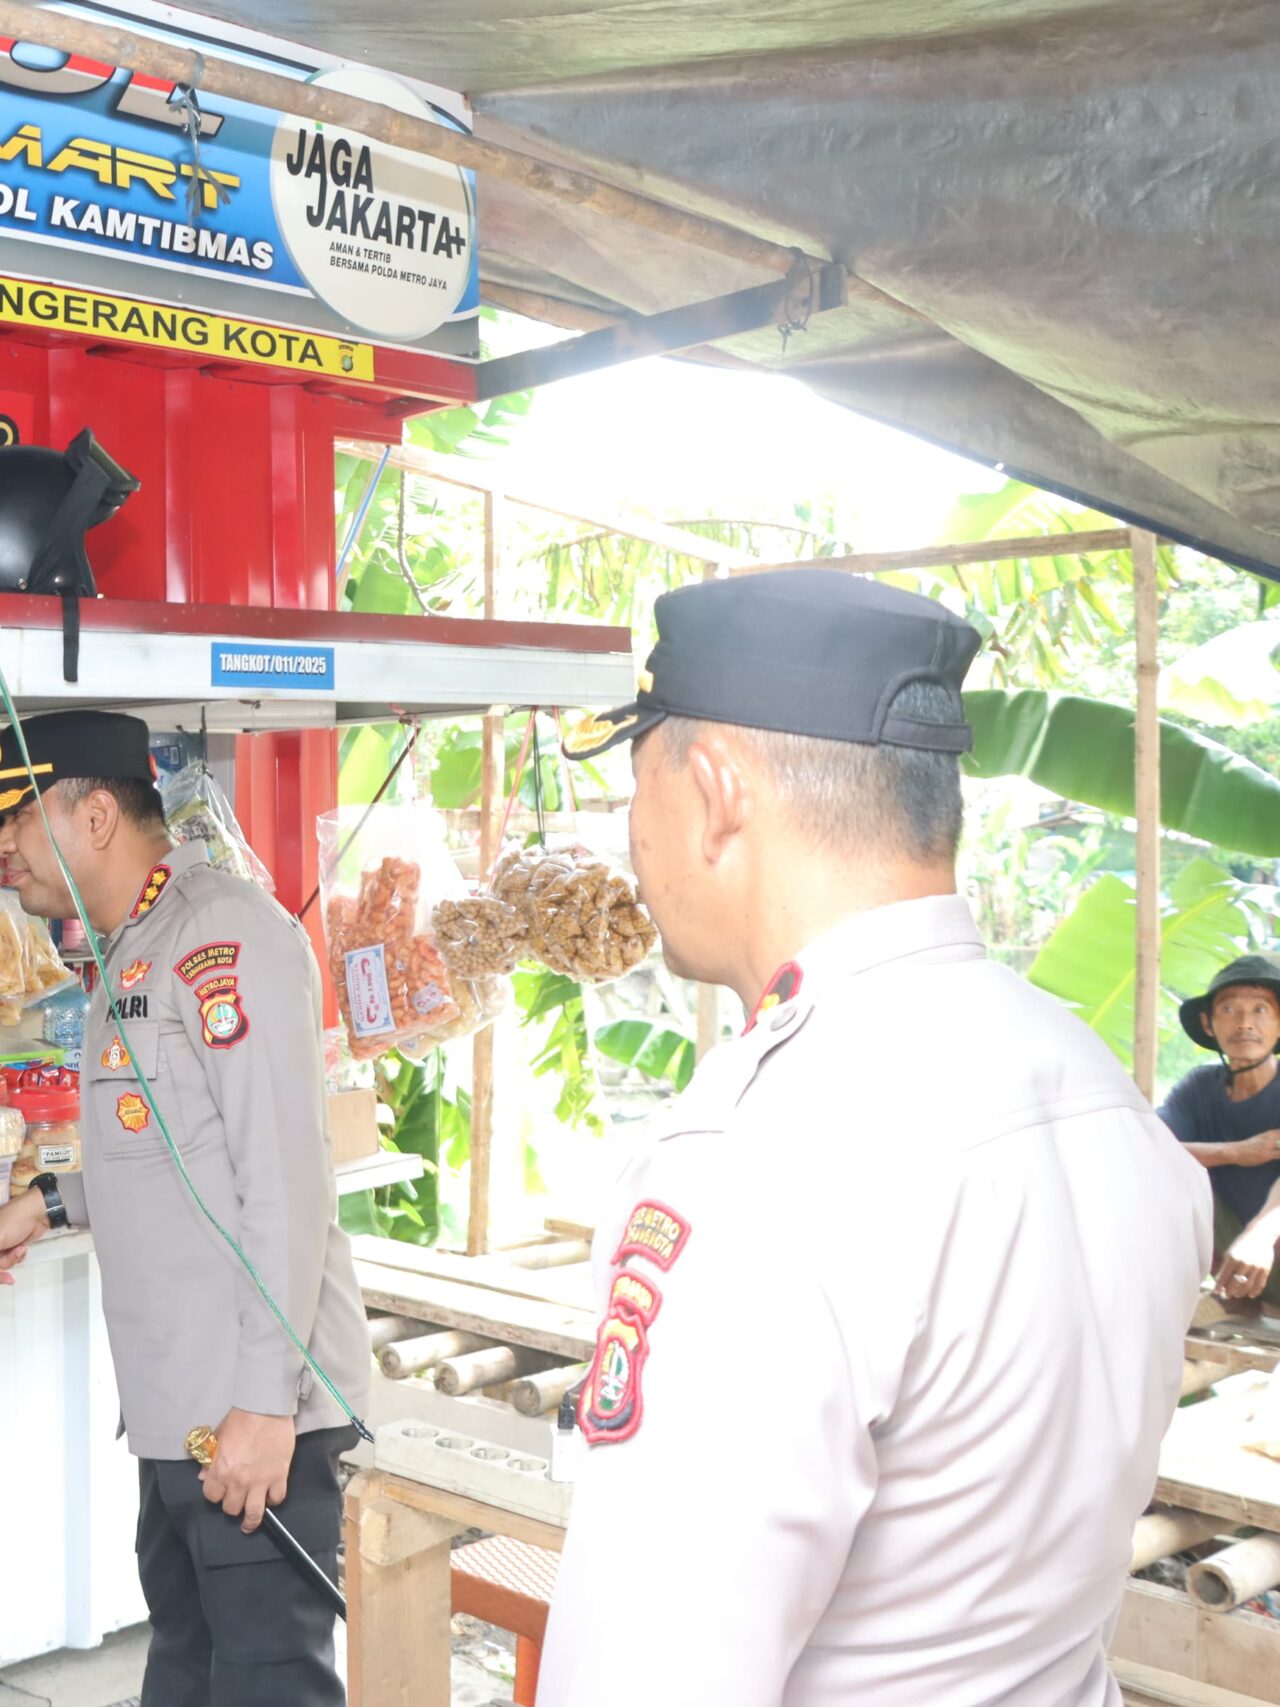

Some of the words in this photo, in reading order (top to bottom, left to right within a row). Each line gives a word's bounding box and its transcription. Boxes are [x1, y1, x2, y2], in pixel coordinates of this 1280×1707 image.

[286, 127, 375, 194] JAGA
[50, 195, 275, 271] KAMTIBMAS
[329, 241, 354, 256] AMAN
[355, 246, 361, 257] &
[363, 248, 392, 264] TERTIB
[330, 256, 370, 273] BERSAMA
[371, 264, 398, 280] POLDA
[399, 271, 427, 286] METRO
[428, 278, 448, 291] JAYA
[222, 323, 324, 368] KOTA
[219, 653, 327, 676] TANGKOT/011/2025
[180, 951, 207, 975] POLRES
[207, 947, 236, 957] METRO
